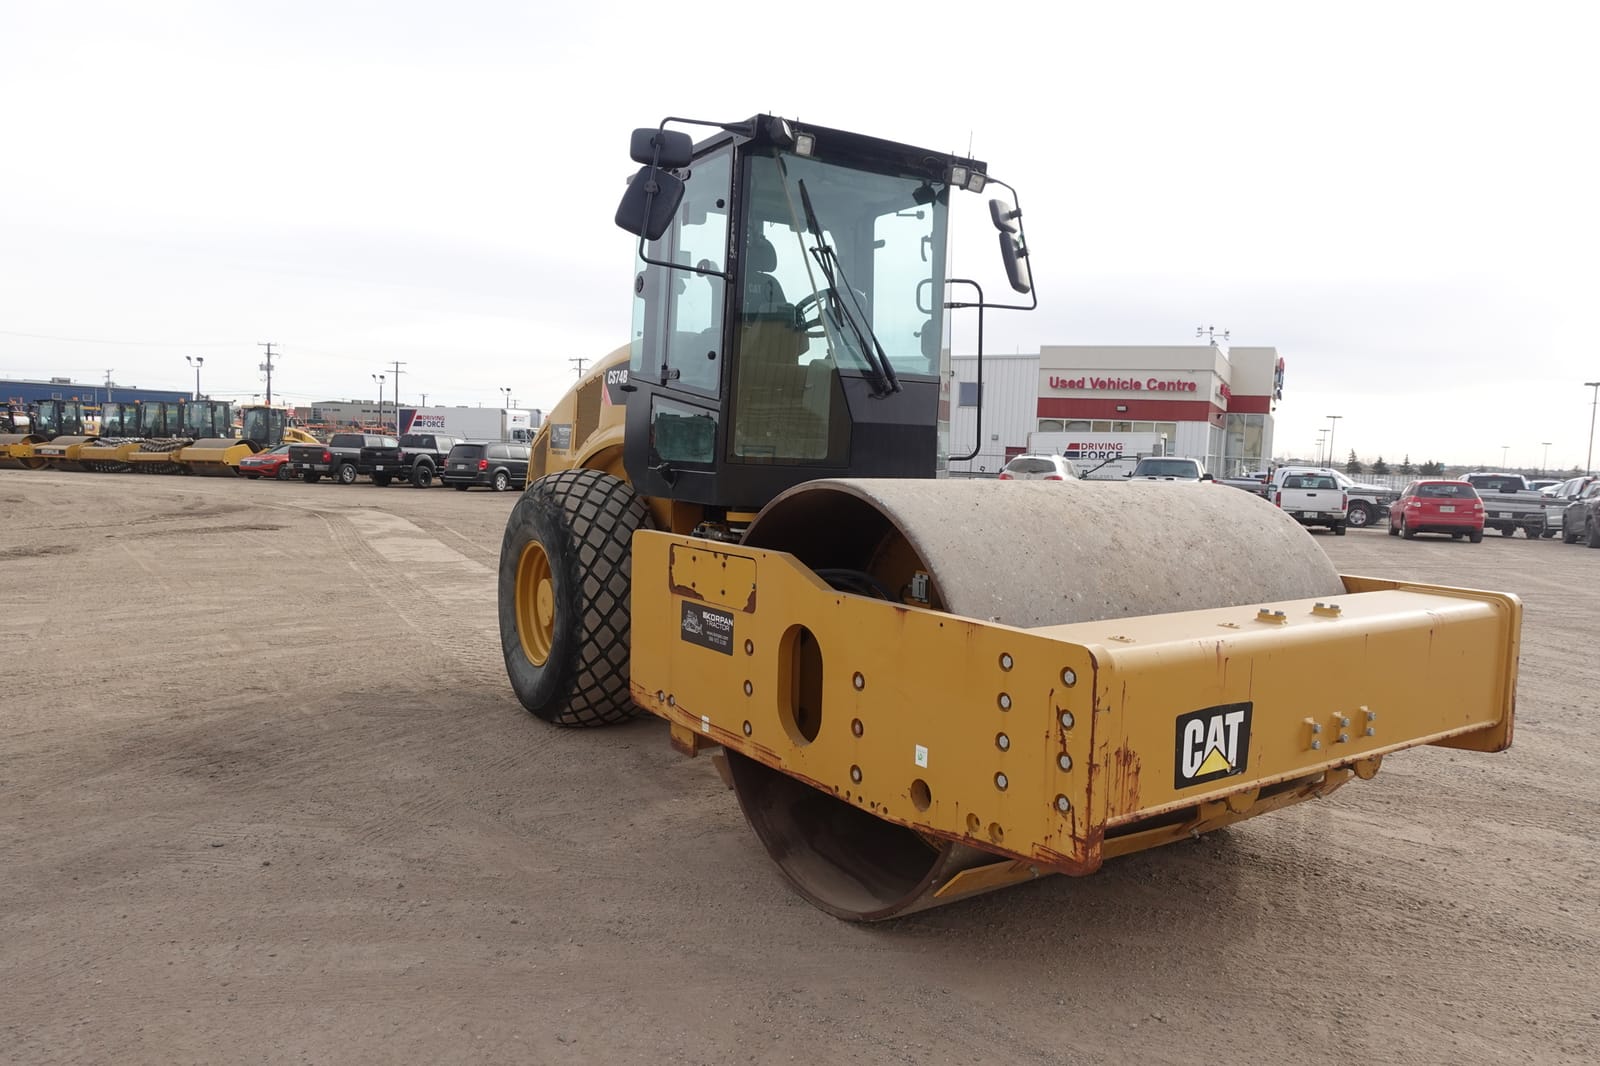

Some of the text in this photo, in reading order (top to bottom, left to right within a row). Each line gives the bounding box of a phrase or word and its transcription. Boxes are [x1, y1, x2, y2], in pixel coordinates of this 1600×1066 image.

[608, 369, 628, 384] CS74B
[1050, 376, 1197, 392] Used Vehicle Centre
[1081, 451, 1122, 460] FORCE
[703, 611, 733, 627] KORPAN
[706, 619, 730, 632] TRACTOR
[1182, 710, 1245, 779] CAT
